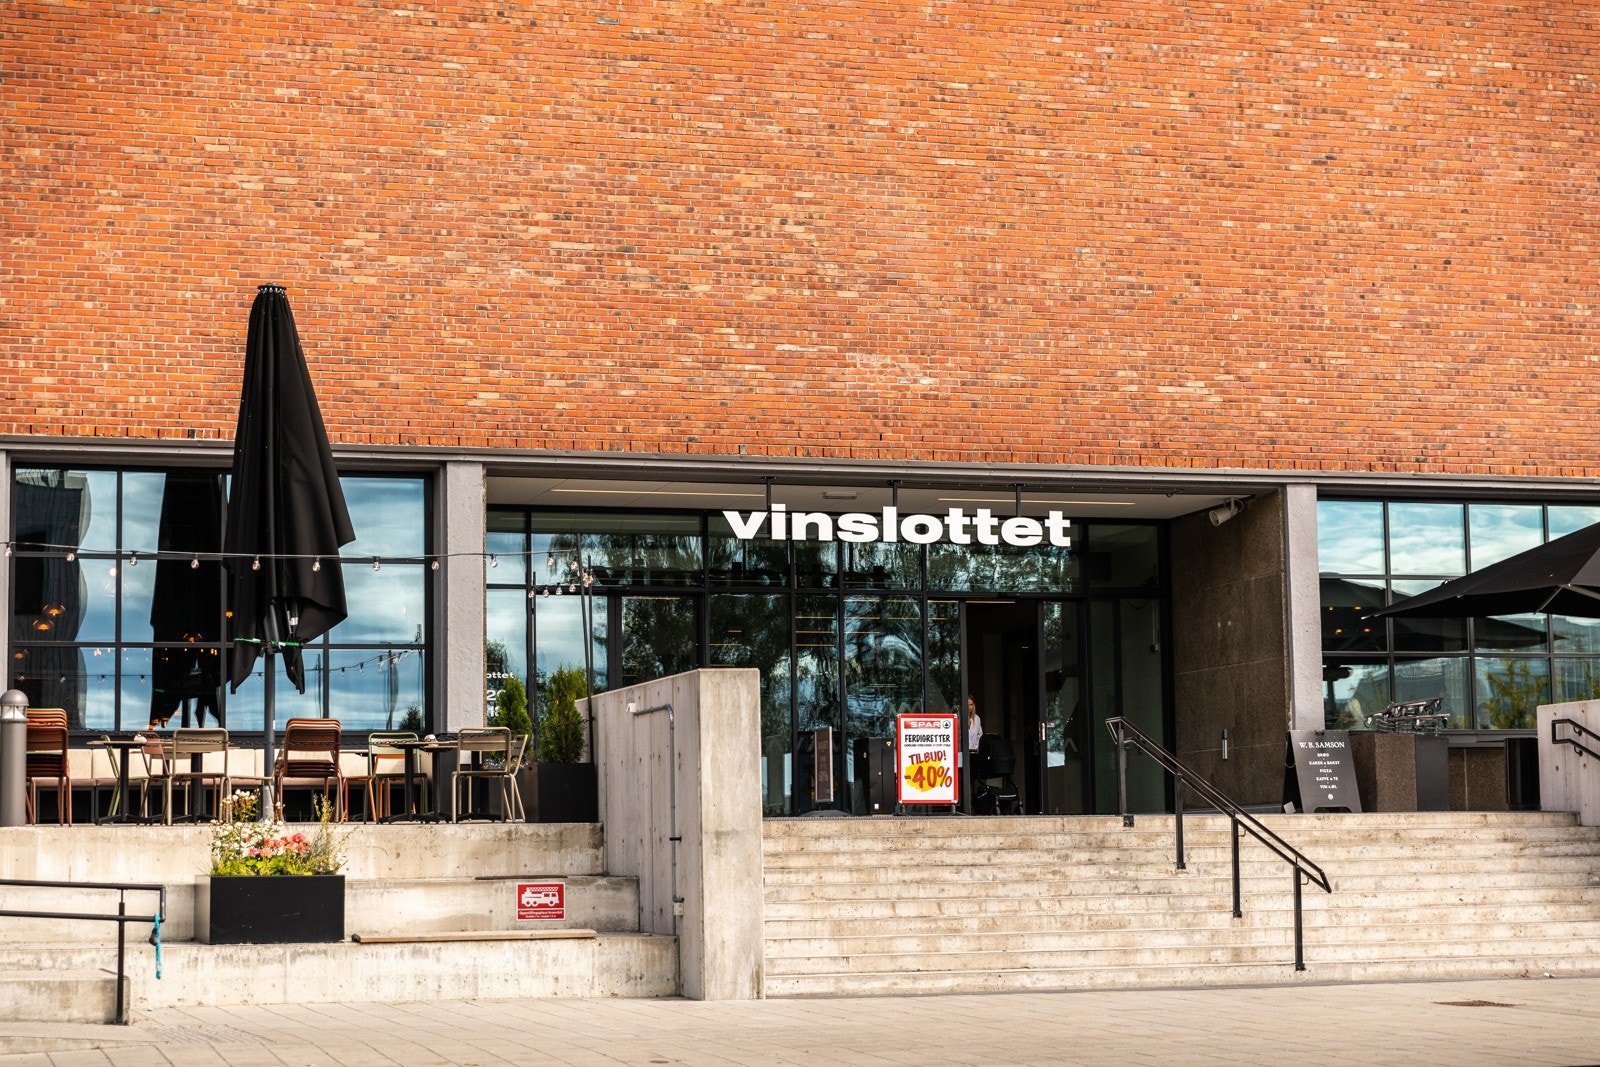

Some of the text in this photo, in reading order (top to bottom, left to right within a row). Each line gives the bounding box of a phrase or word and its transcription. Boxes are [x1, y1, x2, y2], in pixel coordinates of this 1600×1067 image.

[722, 503, 1071, 547] vinslottet
[904, 734, 951, 743] FERDIGRETTER
[1315, 741, 1345, 749] SAMSON
[908, 750, 947, 765] TILBUD!
[904, 765, 953, 789] -40%
